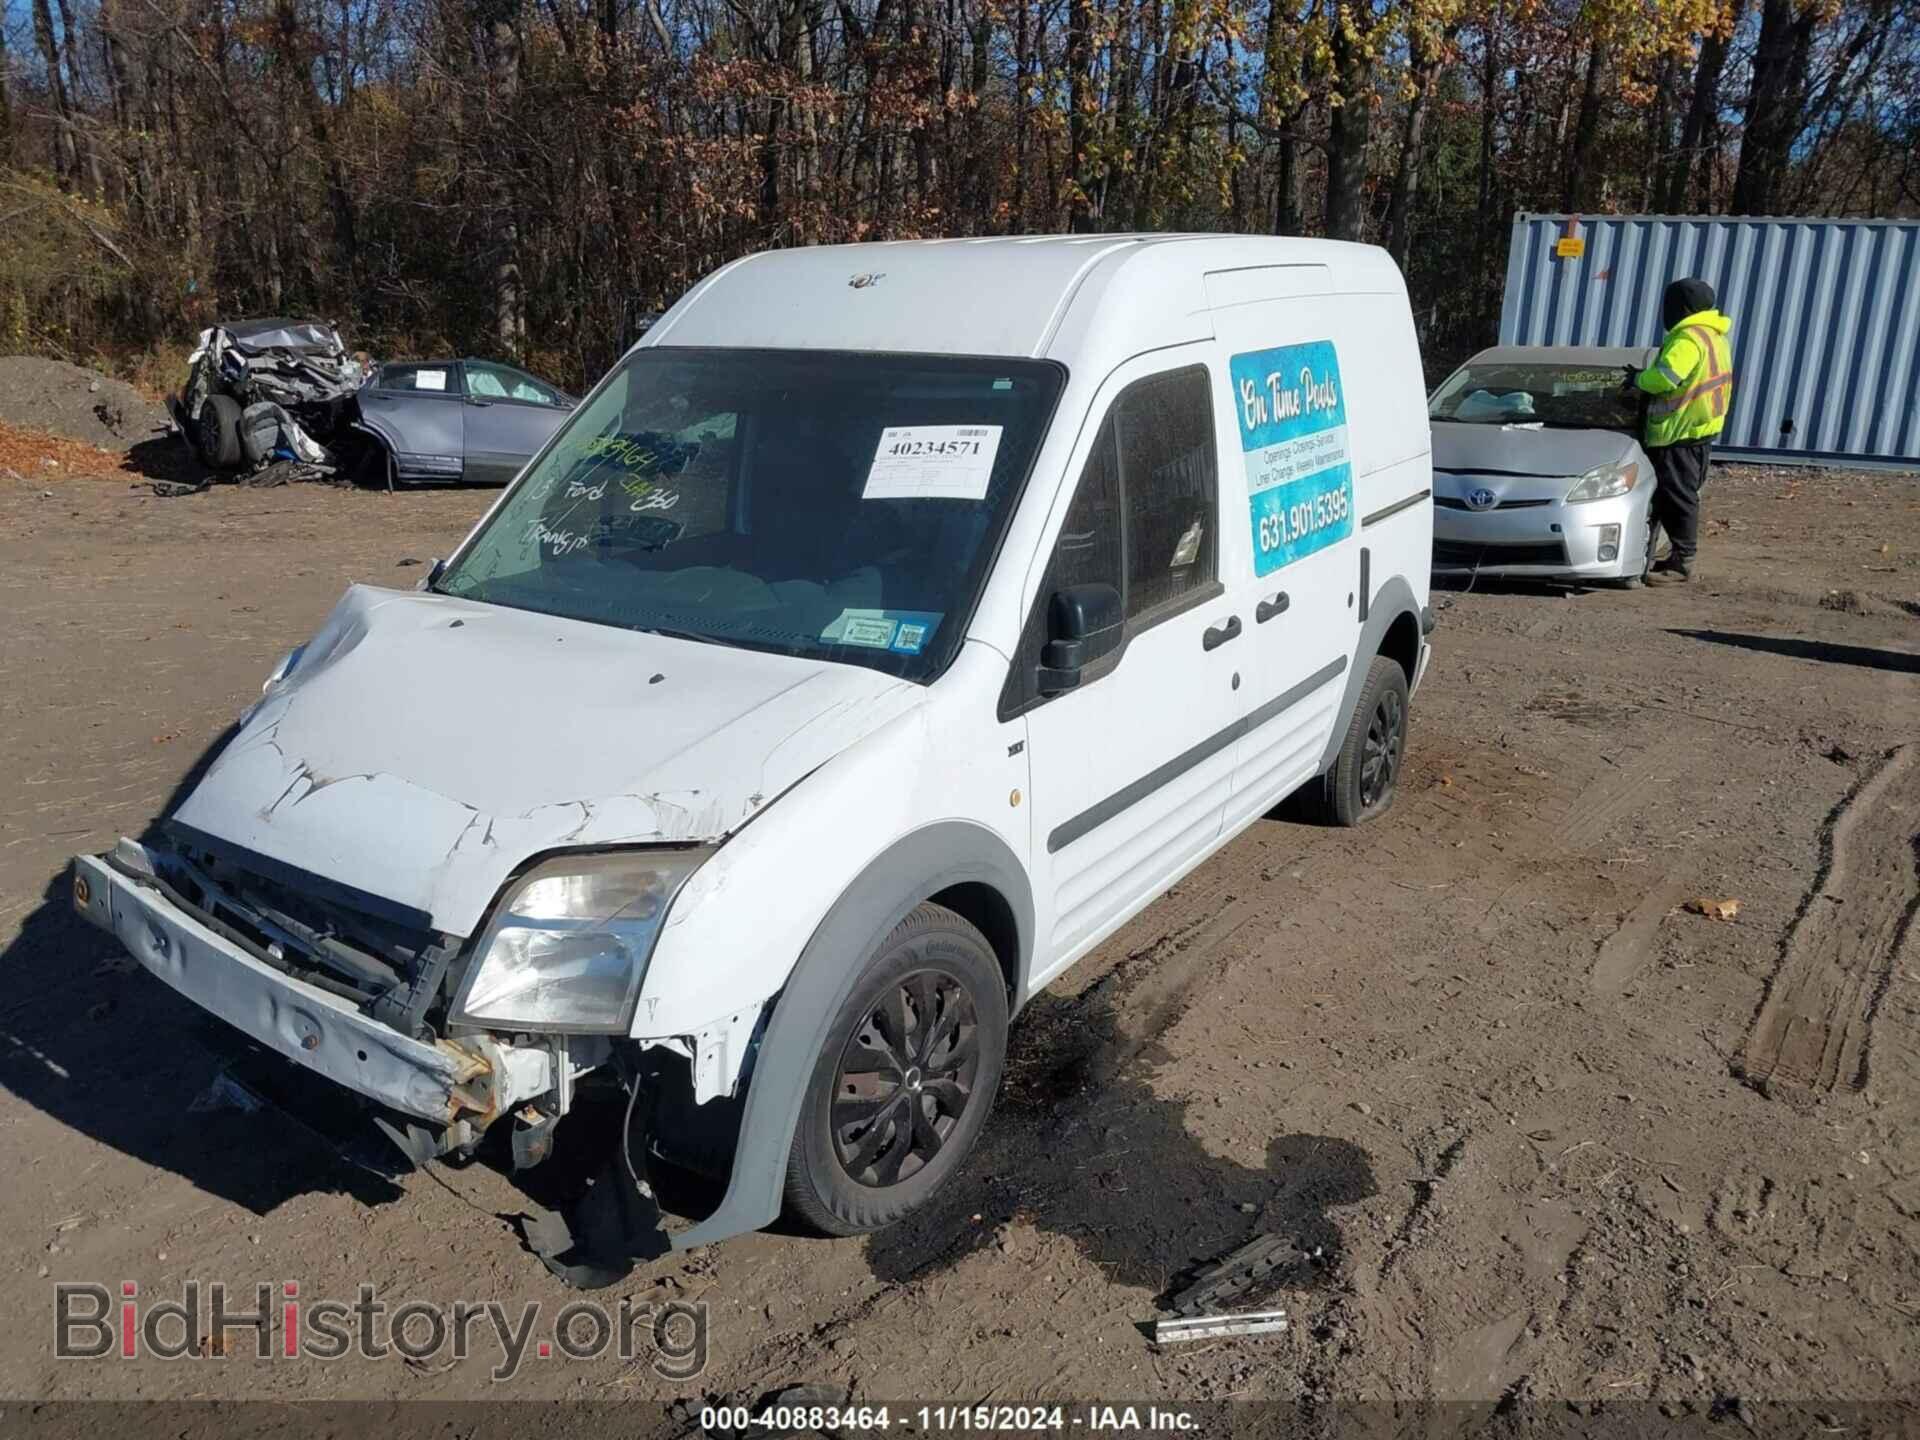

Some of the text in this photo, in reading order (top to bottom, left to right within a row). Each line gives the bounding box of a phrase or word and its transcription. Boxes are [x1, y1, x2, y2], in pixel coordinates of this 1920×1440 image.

[1241, 365, 1337, 430] On Time Pools
[889, 441, 980, 456] 40234571
[563, 478, 609, 501] Ford
[1259, 486, 1348, 553] 631.901.5395
